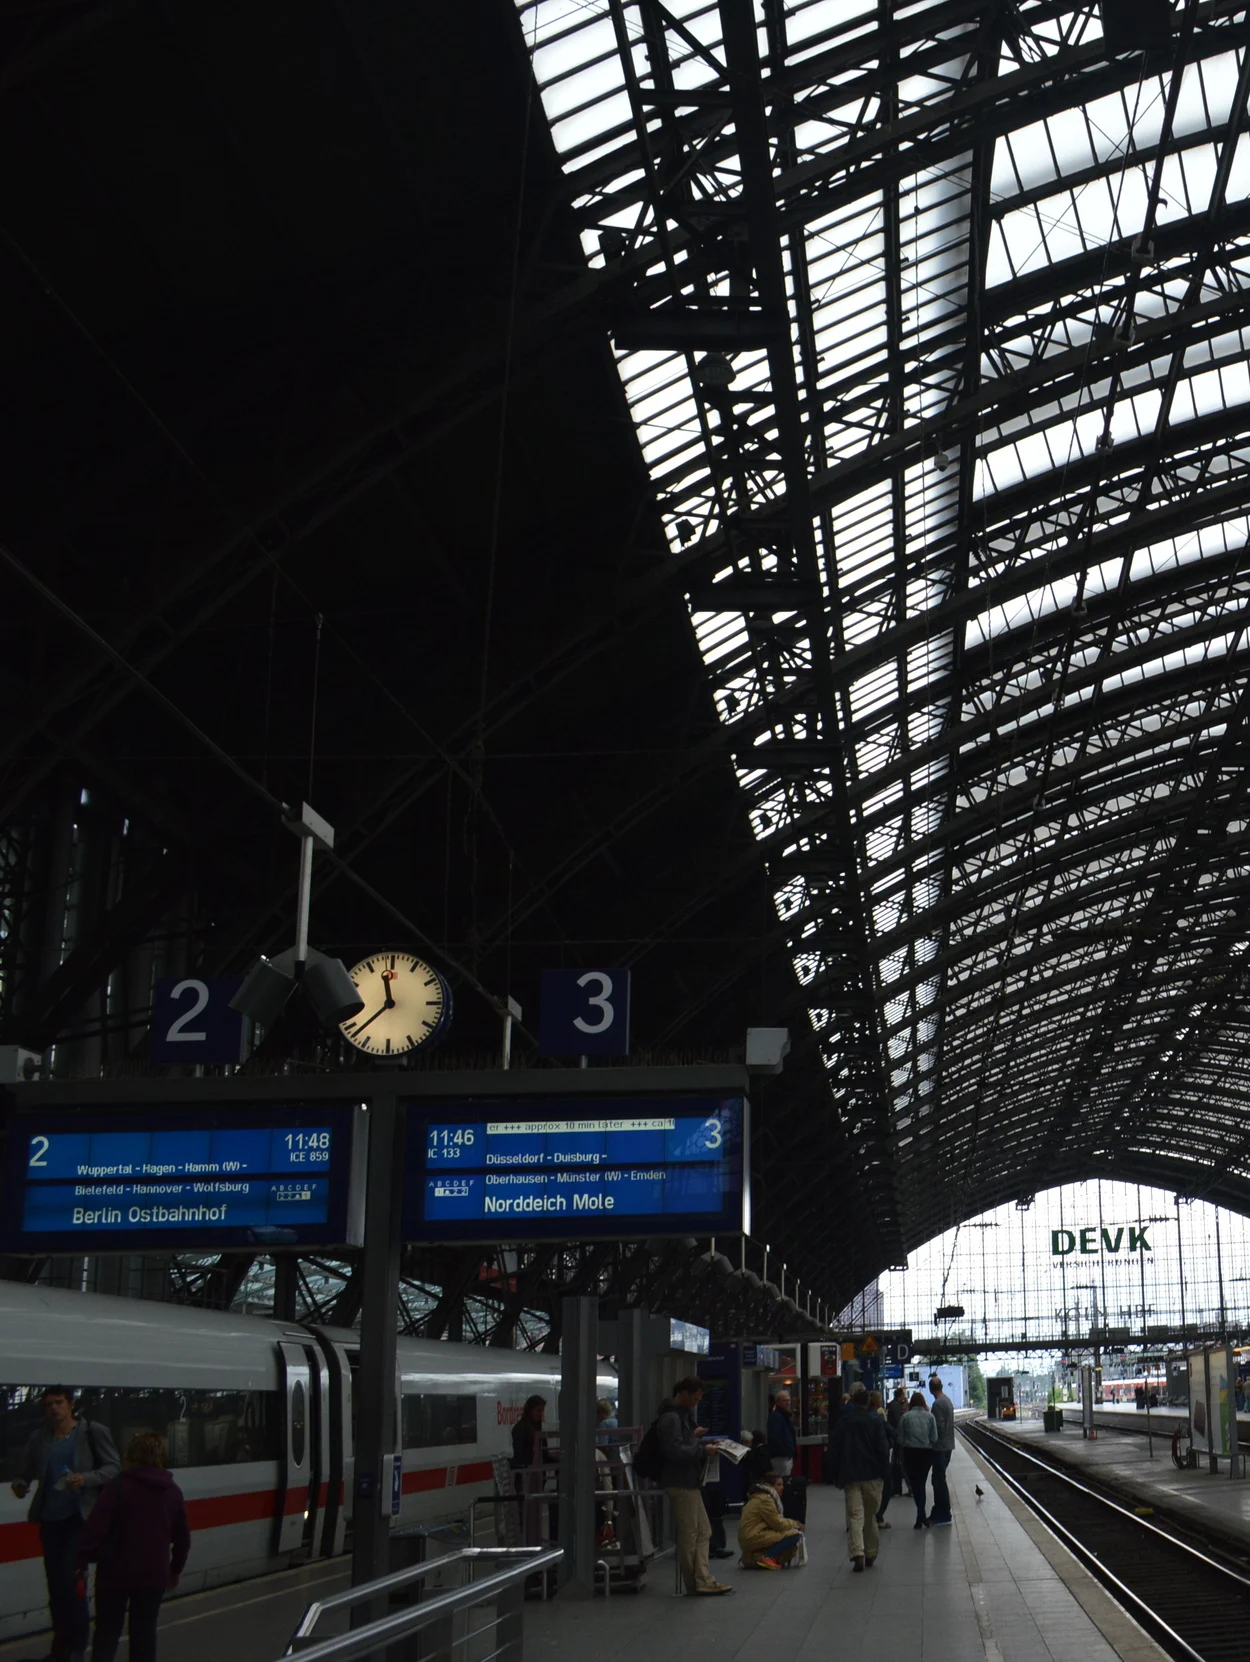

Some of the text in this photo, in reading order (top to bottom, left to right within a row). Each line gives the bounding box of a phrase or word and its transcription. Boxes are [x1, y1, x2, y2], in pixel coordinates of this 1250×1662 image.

[165, 979, 209, 1042] 2
[572, 971, 614, 1034] 3
[523, 1121, 561, 1132] approx
[565, 1121, 575, 1129] 10
[576, 1120, 595, 1129] min
[598, 1120, 623, 1129] later
[704, 1118, 722, 1149] 3
[284, 1132, 330, 1150] 11:48
[430, 1129, 475, 1146] 11:46
[29, 1135, 49, 1167] 2
[290, 1151, 329, 1162] ICE 859
[427, 1147, 460, 1159] IC 133
[486, 1152, 544, 1165] Düsseldorf
[554, 1152, 600, 1165] Duisburg
[77, 1164, 133, 1178] Wuppertal
[142, 1163, 176, 1176] Hagen
[184, 1162, 220, 1172] Hamm
[222, 1161, 240, 1172] (W)
[485, 1174, 548, 1185] Oberhausen
[557, 1172, 600, 1183] Münster
[604, 1171, 622, 1181] (W)
[630, 1170, 666, 1181] Emden
[75, 1184, 124, 1196] Bielefeld
[132, 1184, 183, 1194] Hannover
[193, 1182, 249, 1194] Wolfsburg
[484, 1193, 615, 1213] Norddeich Mole
[72, 1204, 227, 1224] Berlin Ostbahnhof
[1051, 1226, 1152, 1256] DEVK
[897, 1344, 909, 1360] D
